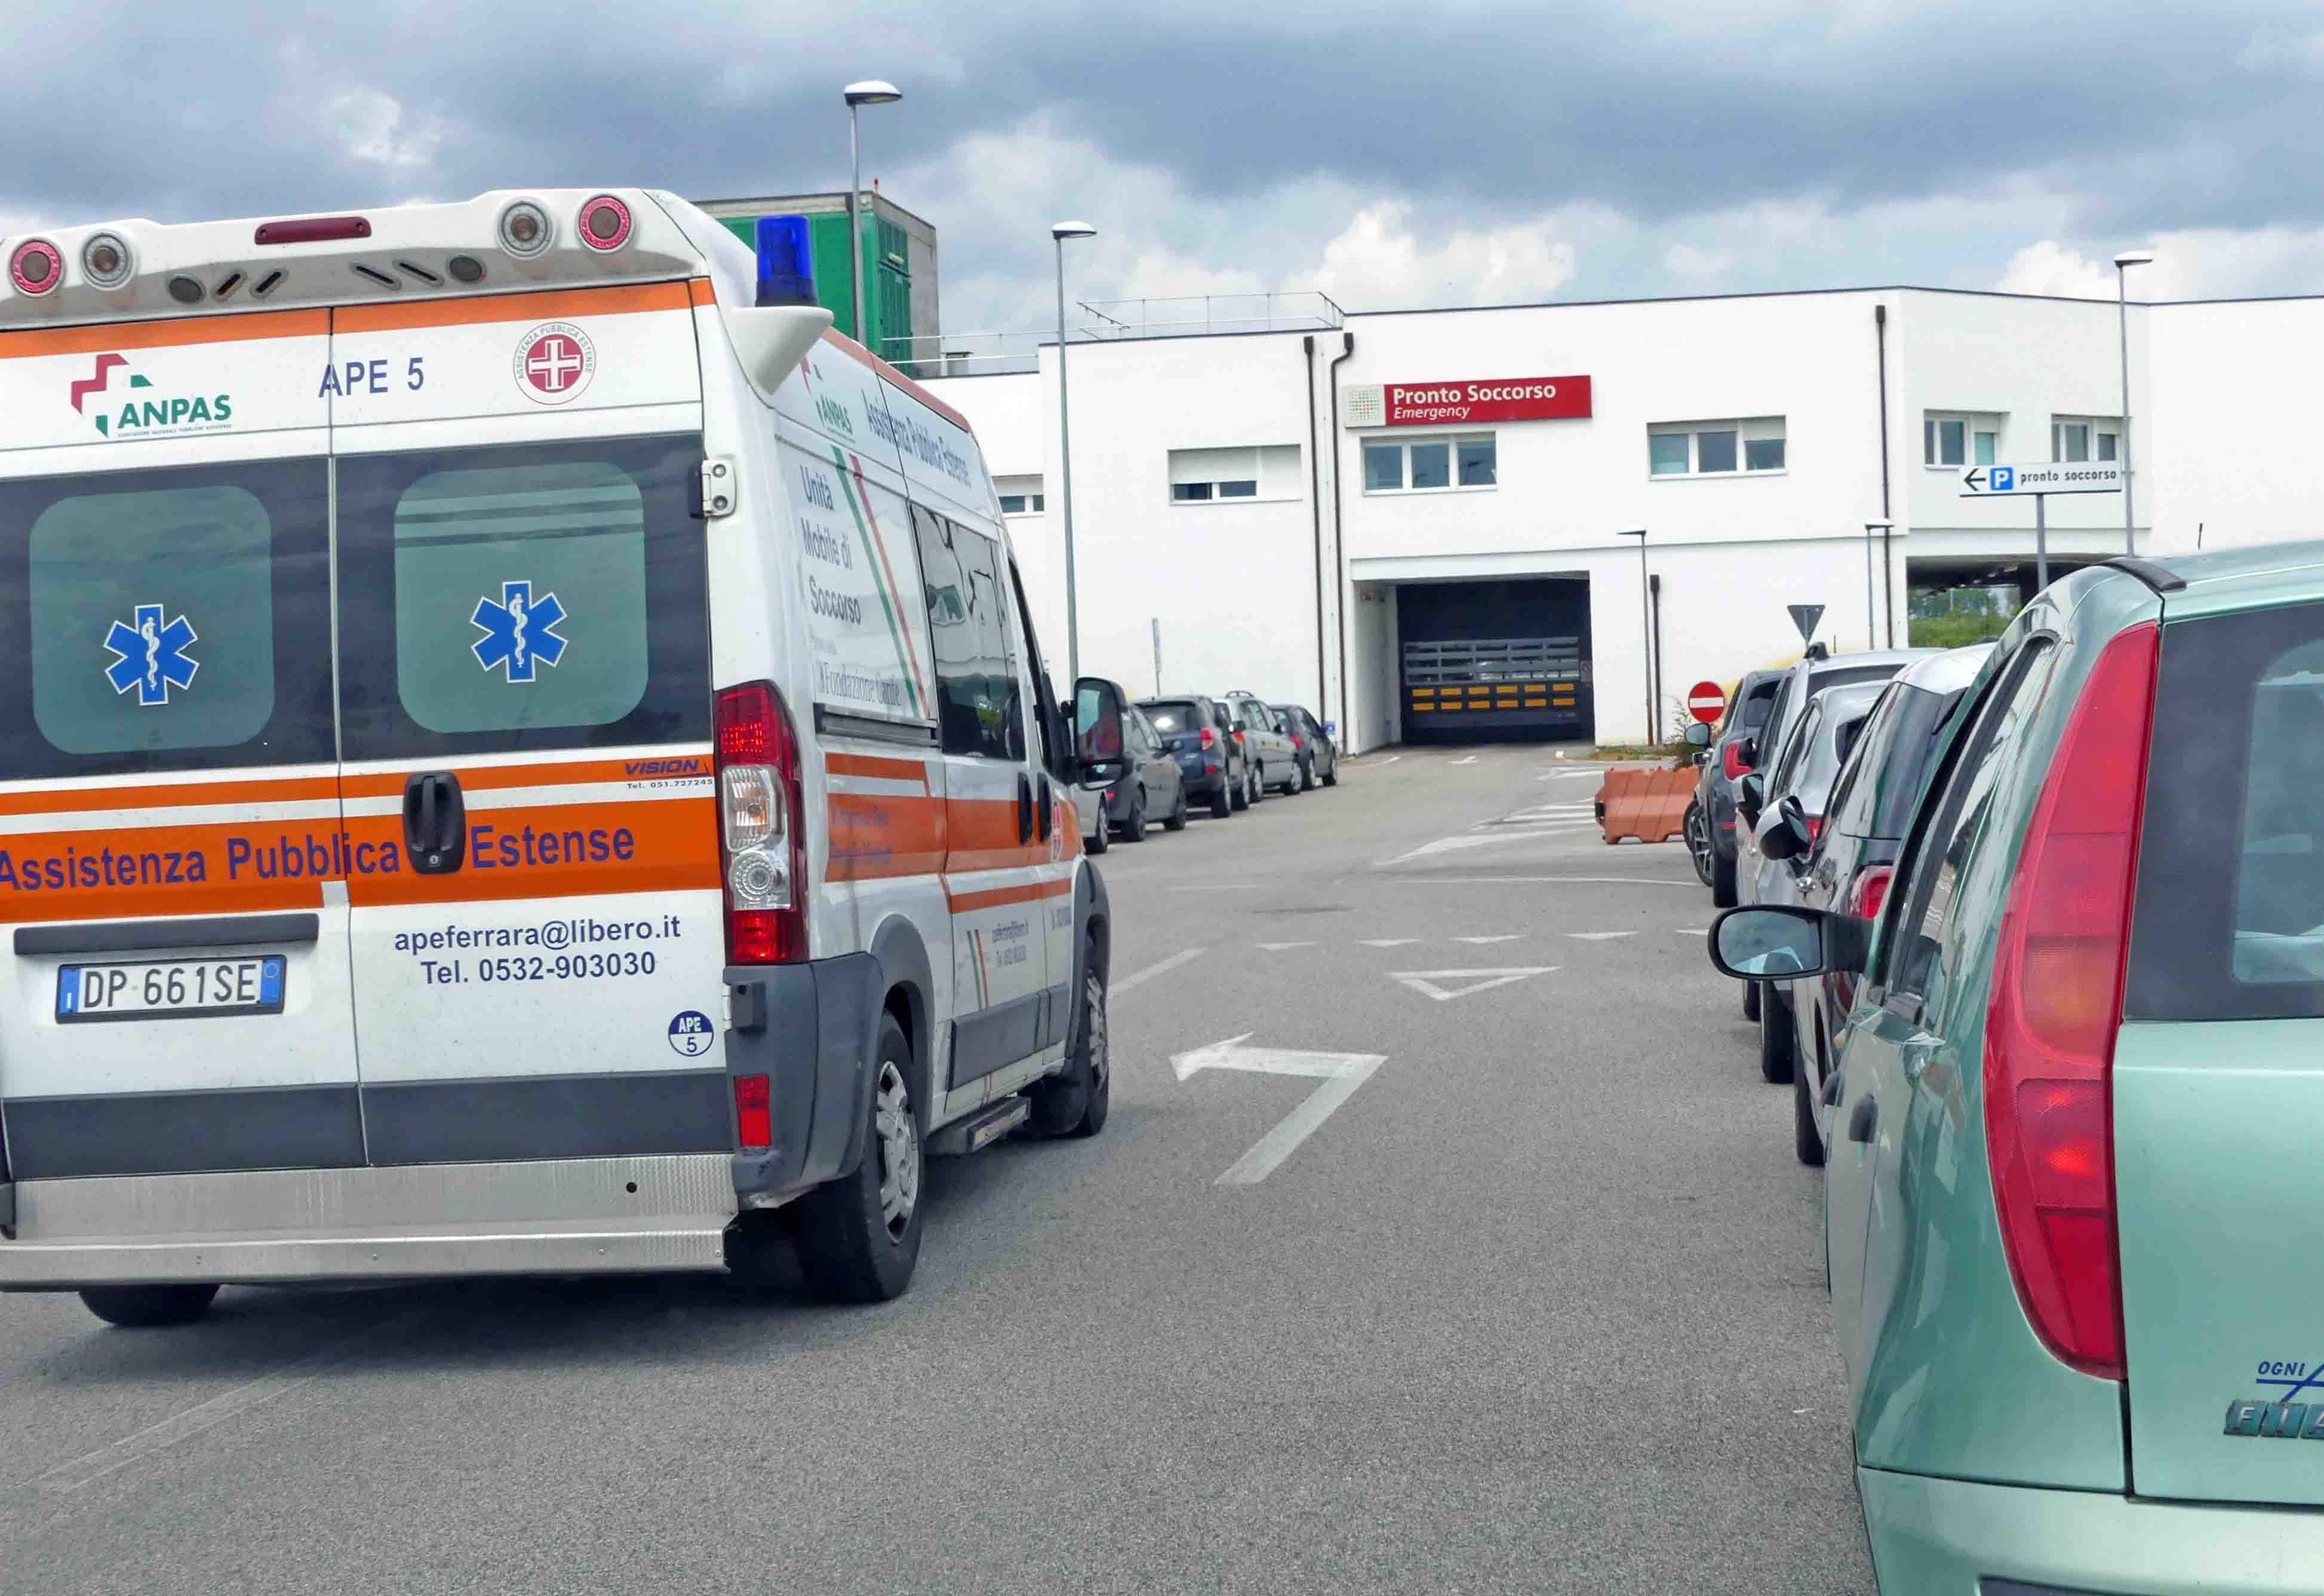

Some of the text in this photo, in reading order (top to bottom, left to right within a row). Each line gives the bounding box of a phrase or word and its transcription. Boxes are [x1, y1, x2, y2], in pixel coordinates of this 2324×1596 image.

[318, 357, 424, 398] APE 5
[1393, 383, 1557, 404] Pronto Soccorso
[117, 394, 232, 429] ANPAS
[1393, 405, 1470, 420] Emergency
[800, 464, 835, 511] Unità
[1994, 470, 2117, 488] P pronto soccorso
[801, 517, 853, 570] Mobile di
[809, 575, 861, 625] Soccorso
[626, 759, 699, 775] VISION
[0, 825, 635, 890] Assistenza Pubblica Estense
[394, 914, 681, 953] apeferrara@libero.it
[420, 952, 656, 984] Tel. 0532-903030
[84, 963, 257, 1008] DP 661SE
[678, 1017, 702, 1033] APE
[686, 1037, 697, 1053] 5
[2258, 1361, 2305, 1376] OGNI
